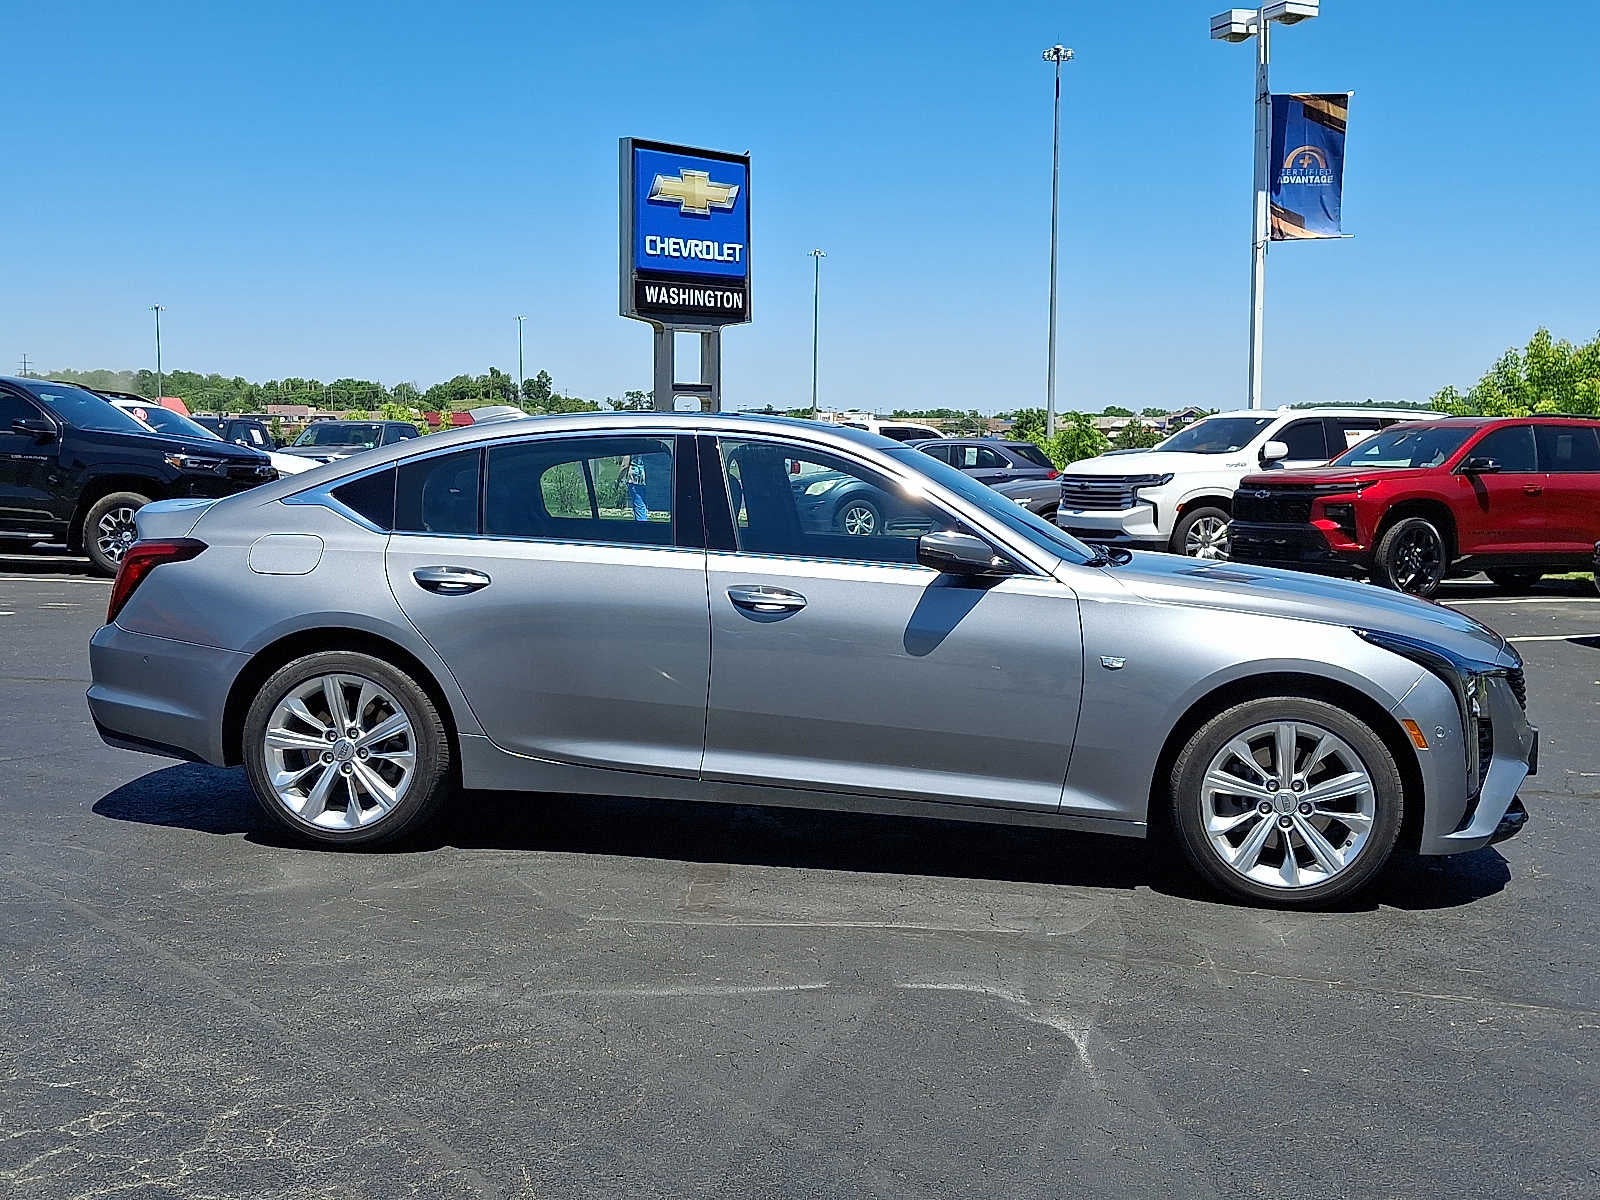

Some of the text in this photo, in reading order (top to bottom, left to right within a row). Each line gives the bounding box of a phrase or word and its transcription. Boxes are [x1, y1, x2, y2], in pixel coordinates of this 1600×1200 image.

[1277, 175, 1334, 184] ADVANTAGE
[645, 235, 743, 261] CHEVROLET
[645, 285, 743, 309] WASHINGTON
